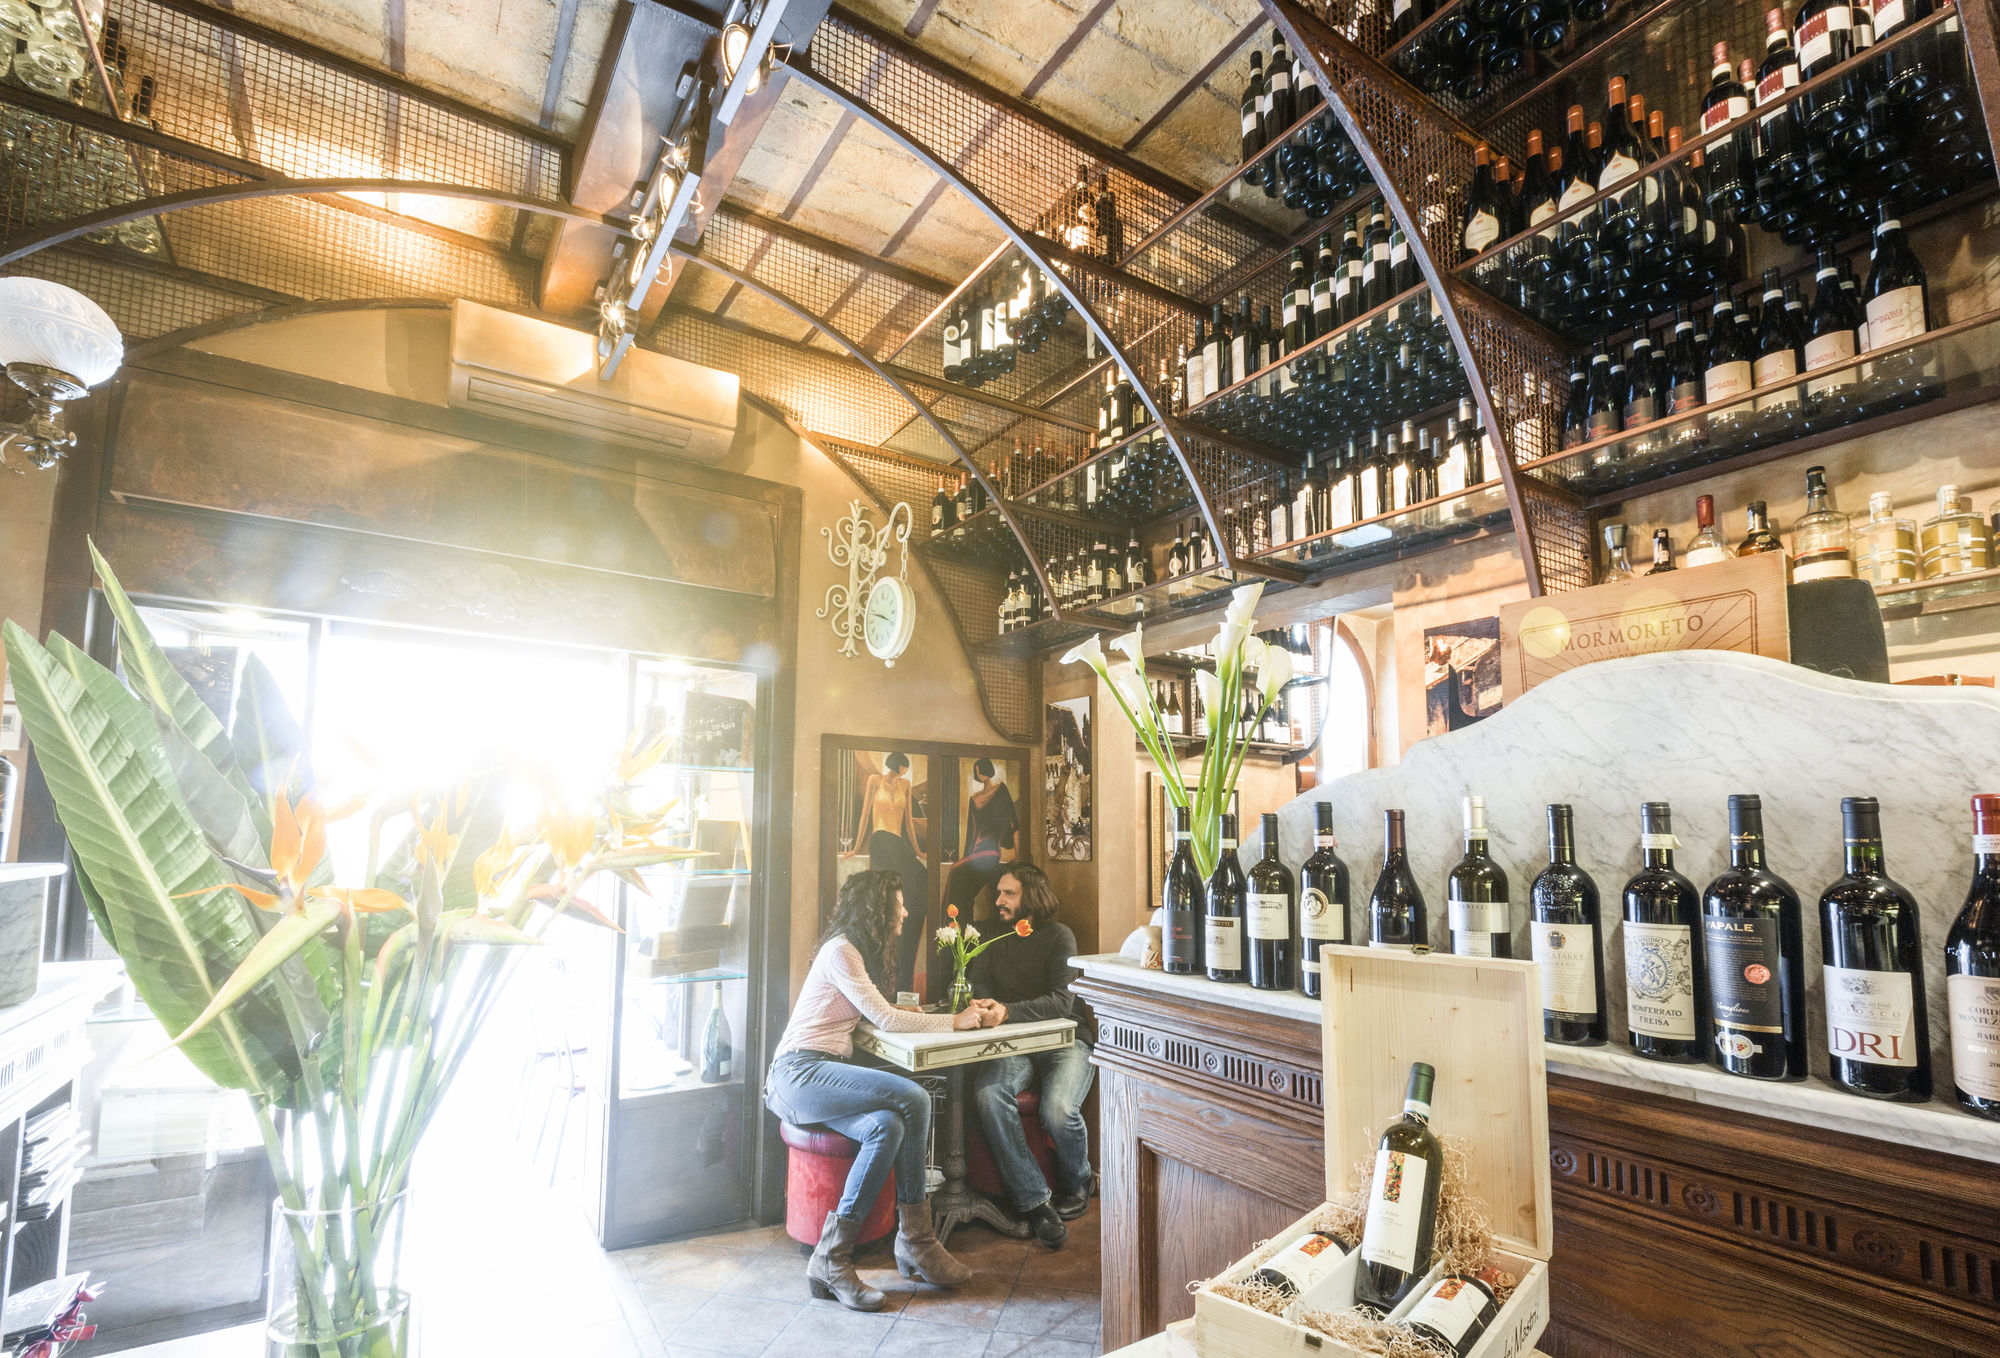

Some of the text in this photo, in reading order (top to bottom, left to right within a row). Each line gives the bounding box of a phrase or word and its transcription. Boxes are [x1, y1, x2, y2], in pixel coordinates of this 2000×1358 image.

[1560, 614, 1704, 652] MORMORETO
[1632, 1004, 1683, 1017] MONFERRATO
[1639, 1015, 1670, 1027] FREISA
[1832, 1025, 1904, 1061] DRI
